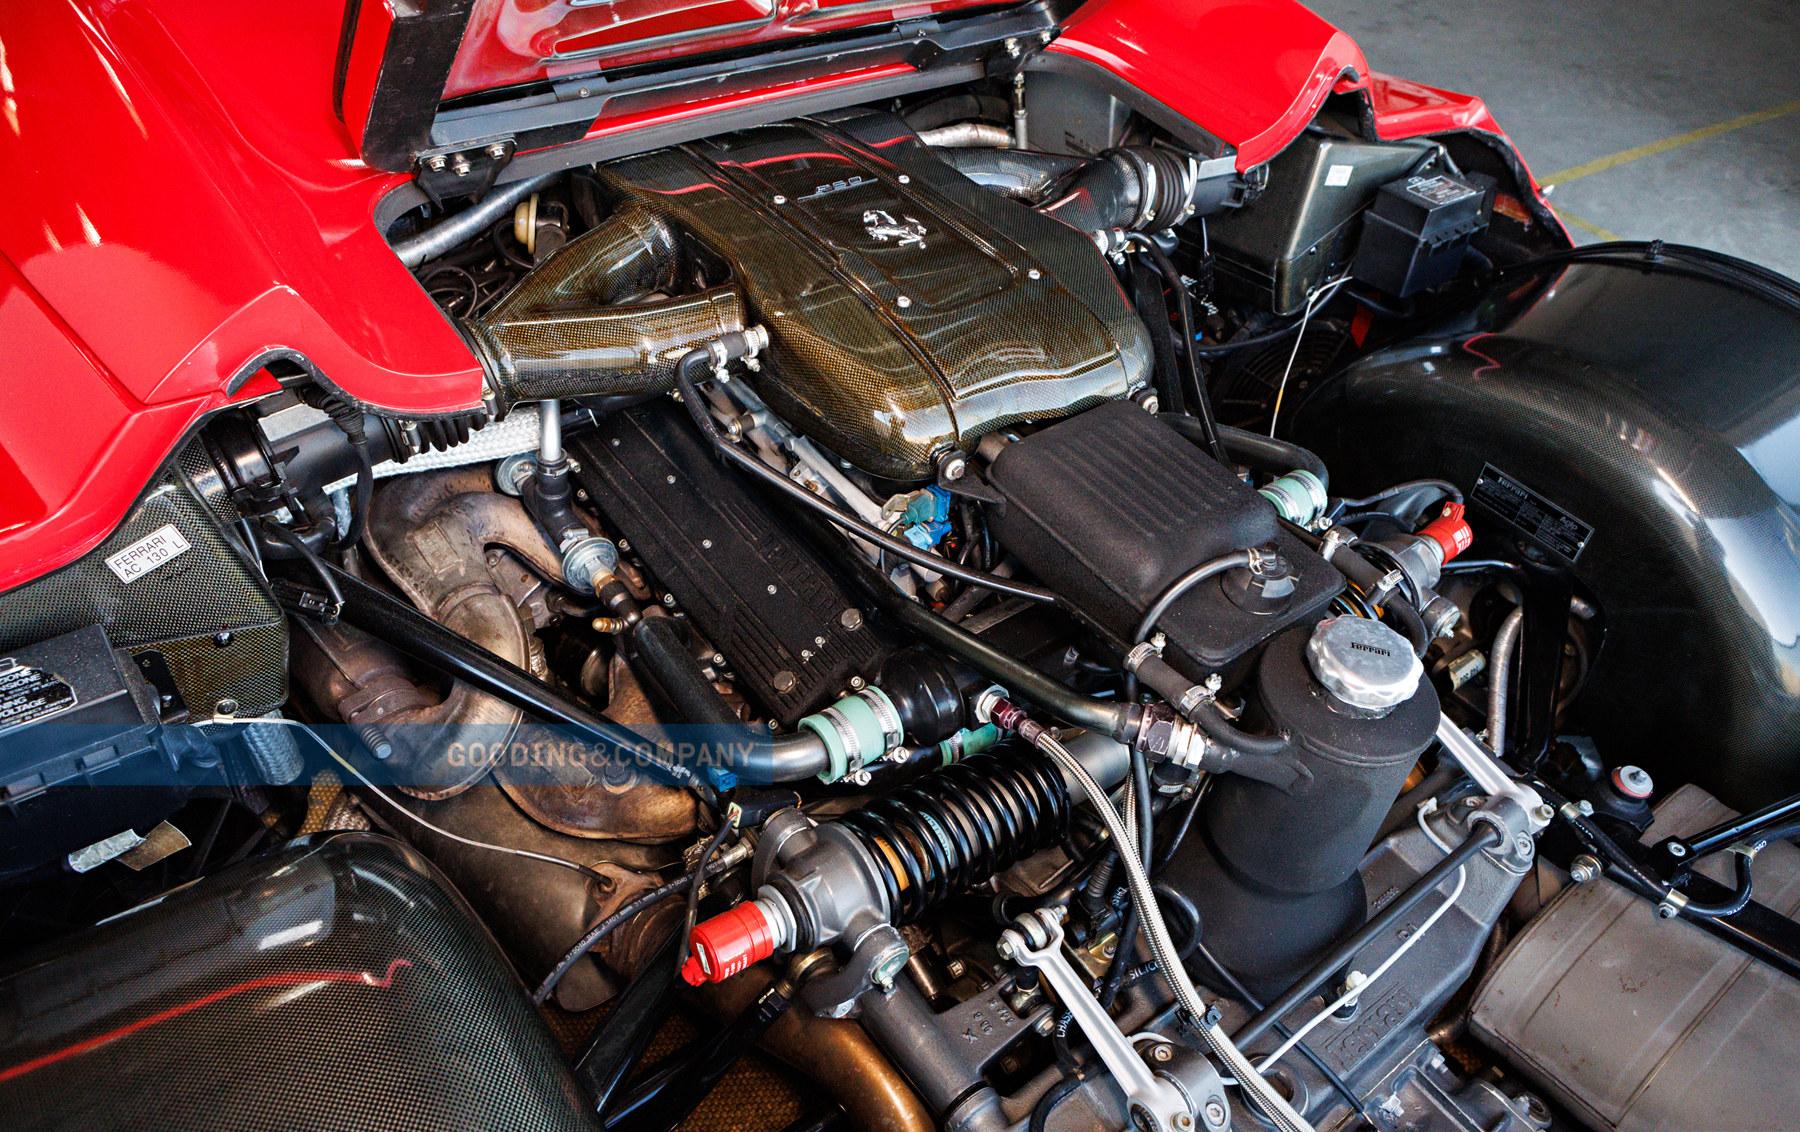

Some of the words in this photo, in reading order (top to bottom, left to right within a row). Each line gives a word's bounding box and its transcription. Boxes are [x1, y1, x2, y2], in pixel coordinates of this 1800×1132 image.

[113, 535, 167, 570] FERRARI
[124, 563, 142, 578] AC
[147, 548, 169, 564] 130
[172, 540, 184, 550] L
[1350, 641, 1391, 657] Ferrari
